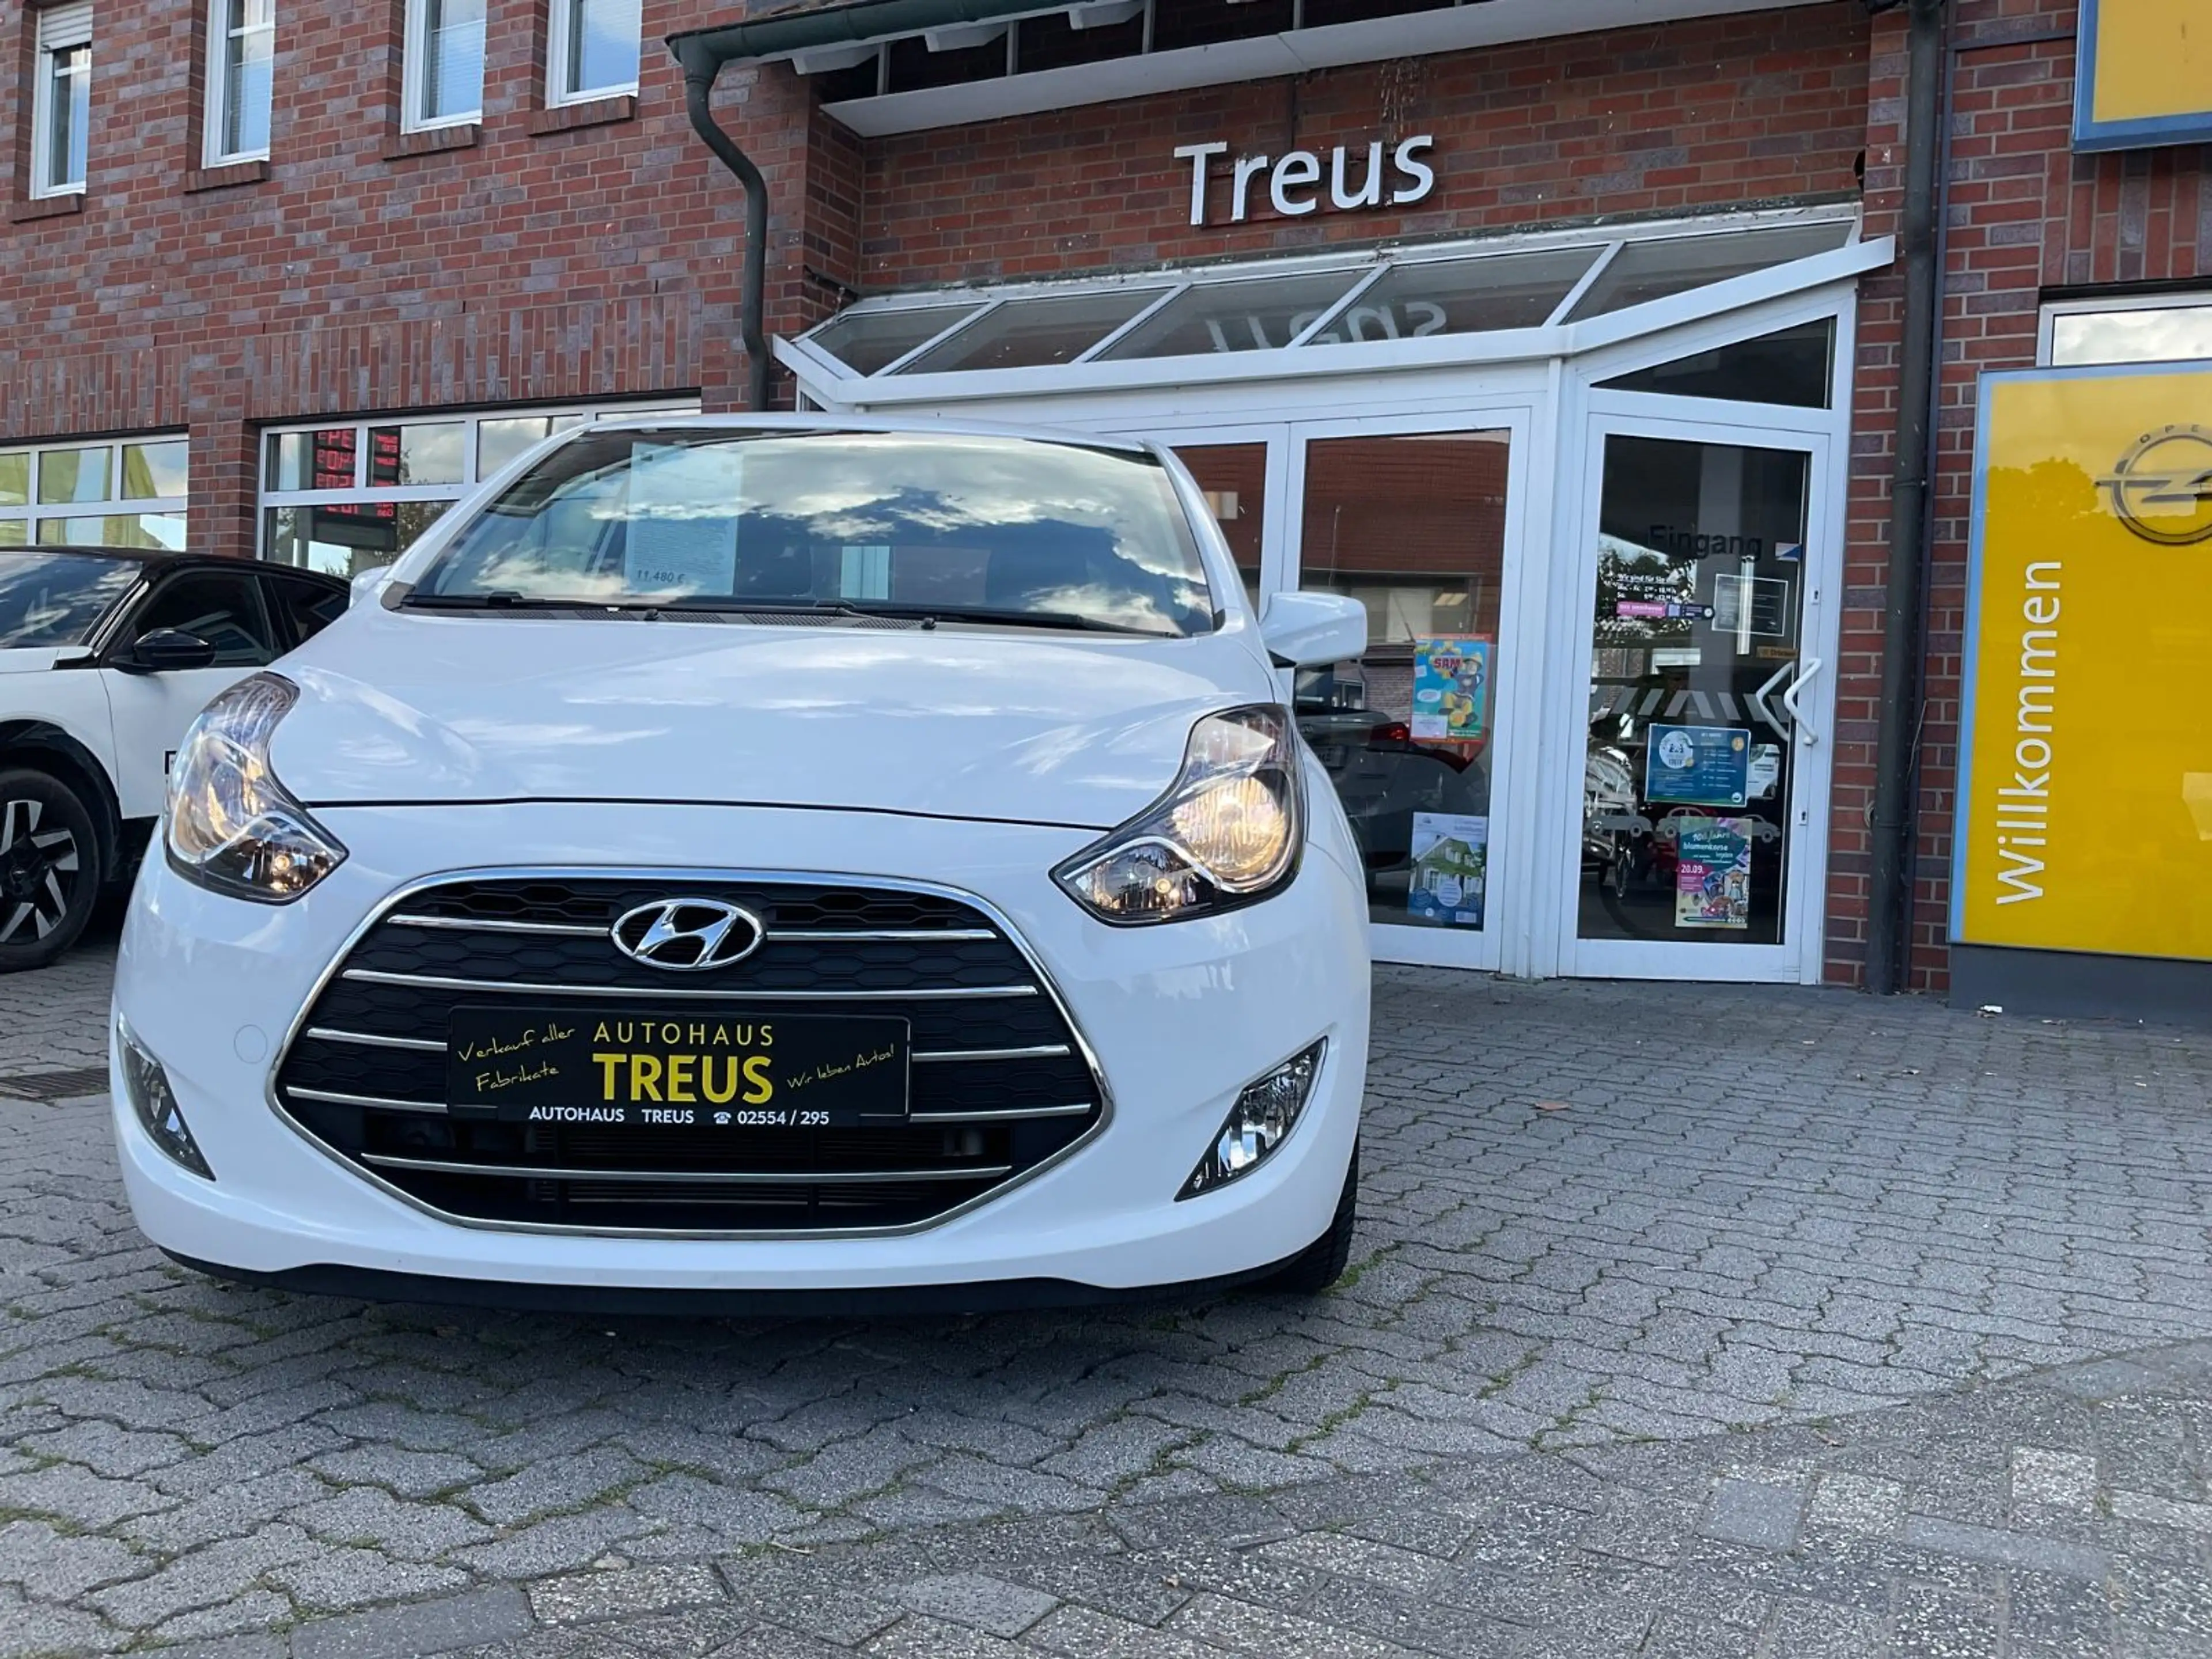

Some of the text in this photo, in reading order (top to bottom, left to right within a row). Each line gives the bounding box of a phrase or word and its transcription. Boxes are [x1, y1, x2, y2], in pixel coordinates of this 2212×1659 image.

[1174, 135, 1434, 226] Treus
[2139, 424, 2200, 444] OPE
[1649, 525, 1763, 562] Eingang
[1434, 657, 1461, 669] SAM
[1997, 562, 2062, 905] Willkommen
[1681, 864, 1704, 873] 20.09.
[457, 1022, 575, 1061] Verkauf aller
[593, 1021, 773, 1046] AUTOHAUS
[476, 1060, 559, 1092] Fabrikate
[592, 1053, 773, 1104] TREUS
[787, 1072, 813, 1088] Wir
[855, 1043, 895, 1068] Autos!
[529, 1107, 625, 1123] AUTOHAUS
[642, 1108, 695, 1124] TREUS
[737, 1110, 786, 1124] 02554
[800, 1111, 830, 1125] 295
